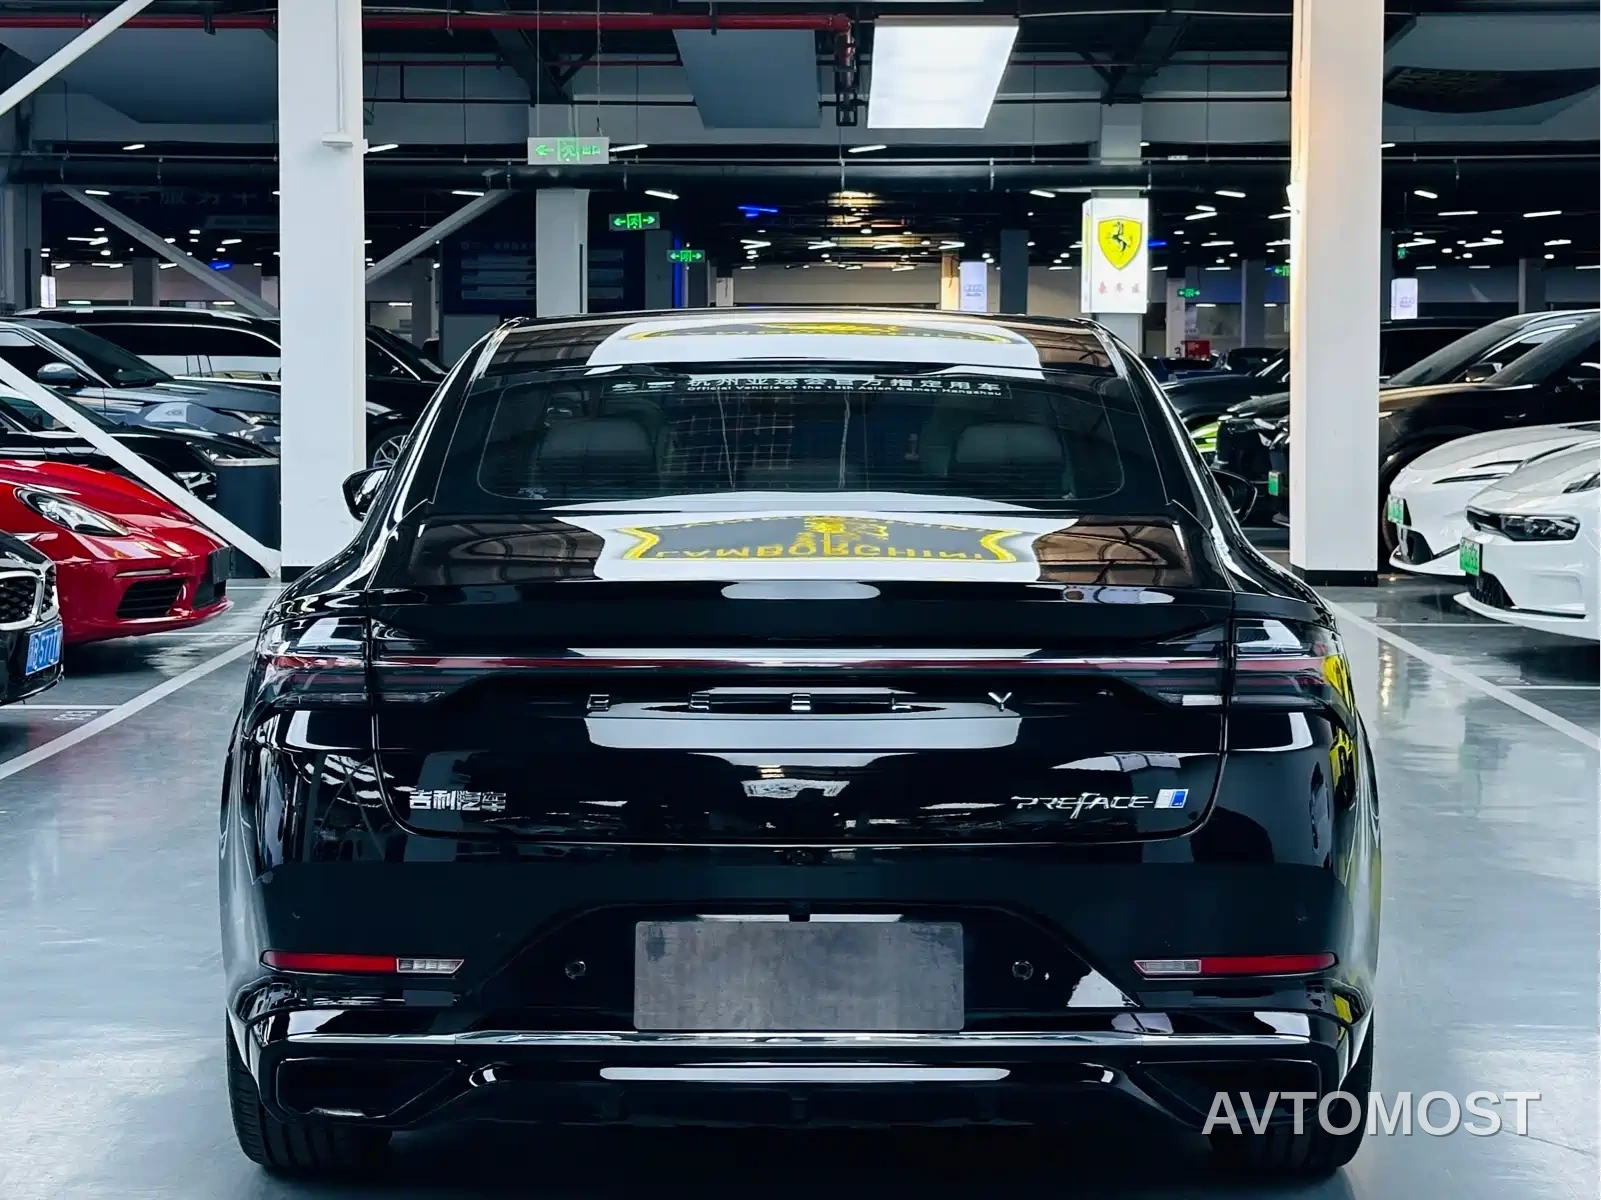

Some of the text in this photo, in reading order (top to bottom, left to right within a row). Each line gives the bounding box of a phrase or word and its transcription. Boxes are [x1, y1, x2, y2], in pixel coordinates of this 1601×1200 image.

[409, 789, 507, 812] 吉利汽车
[1011, 792, 1154, 819] PREFACE
